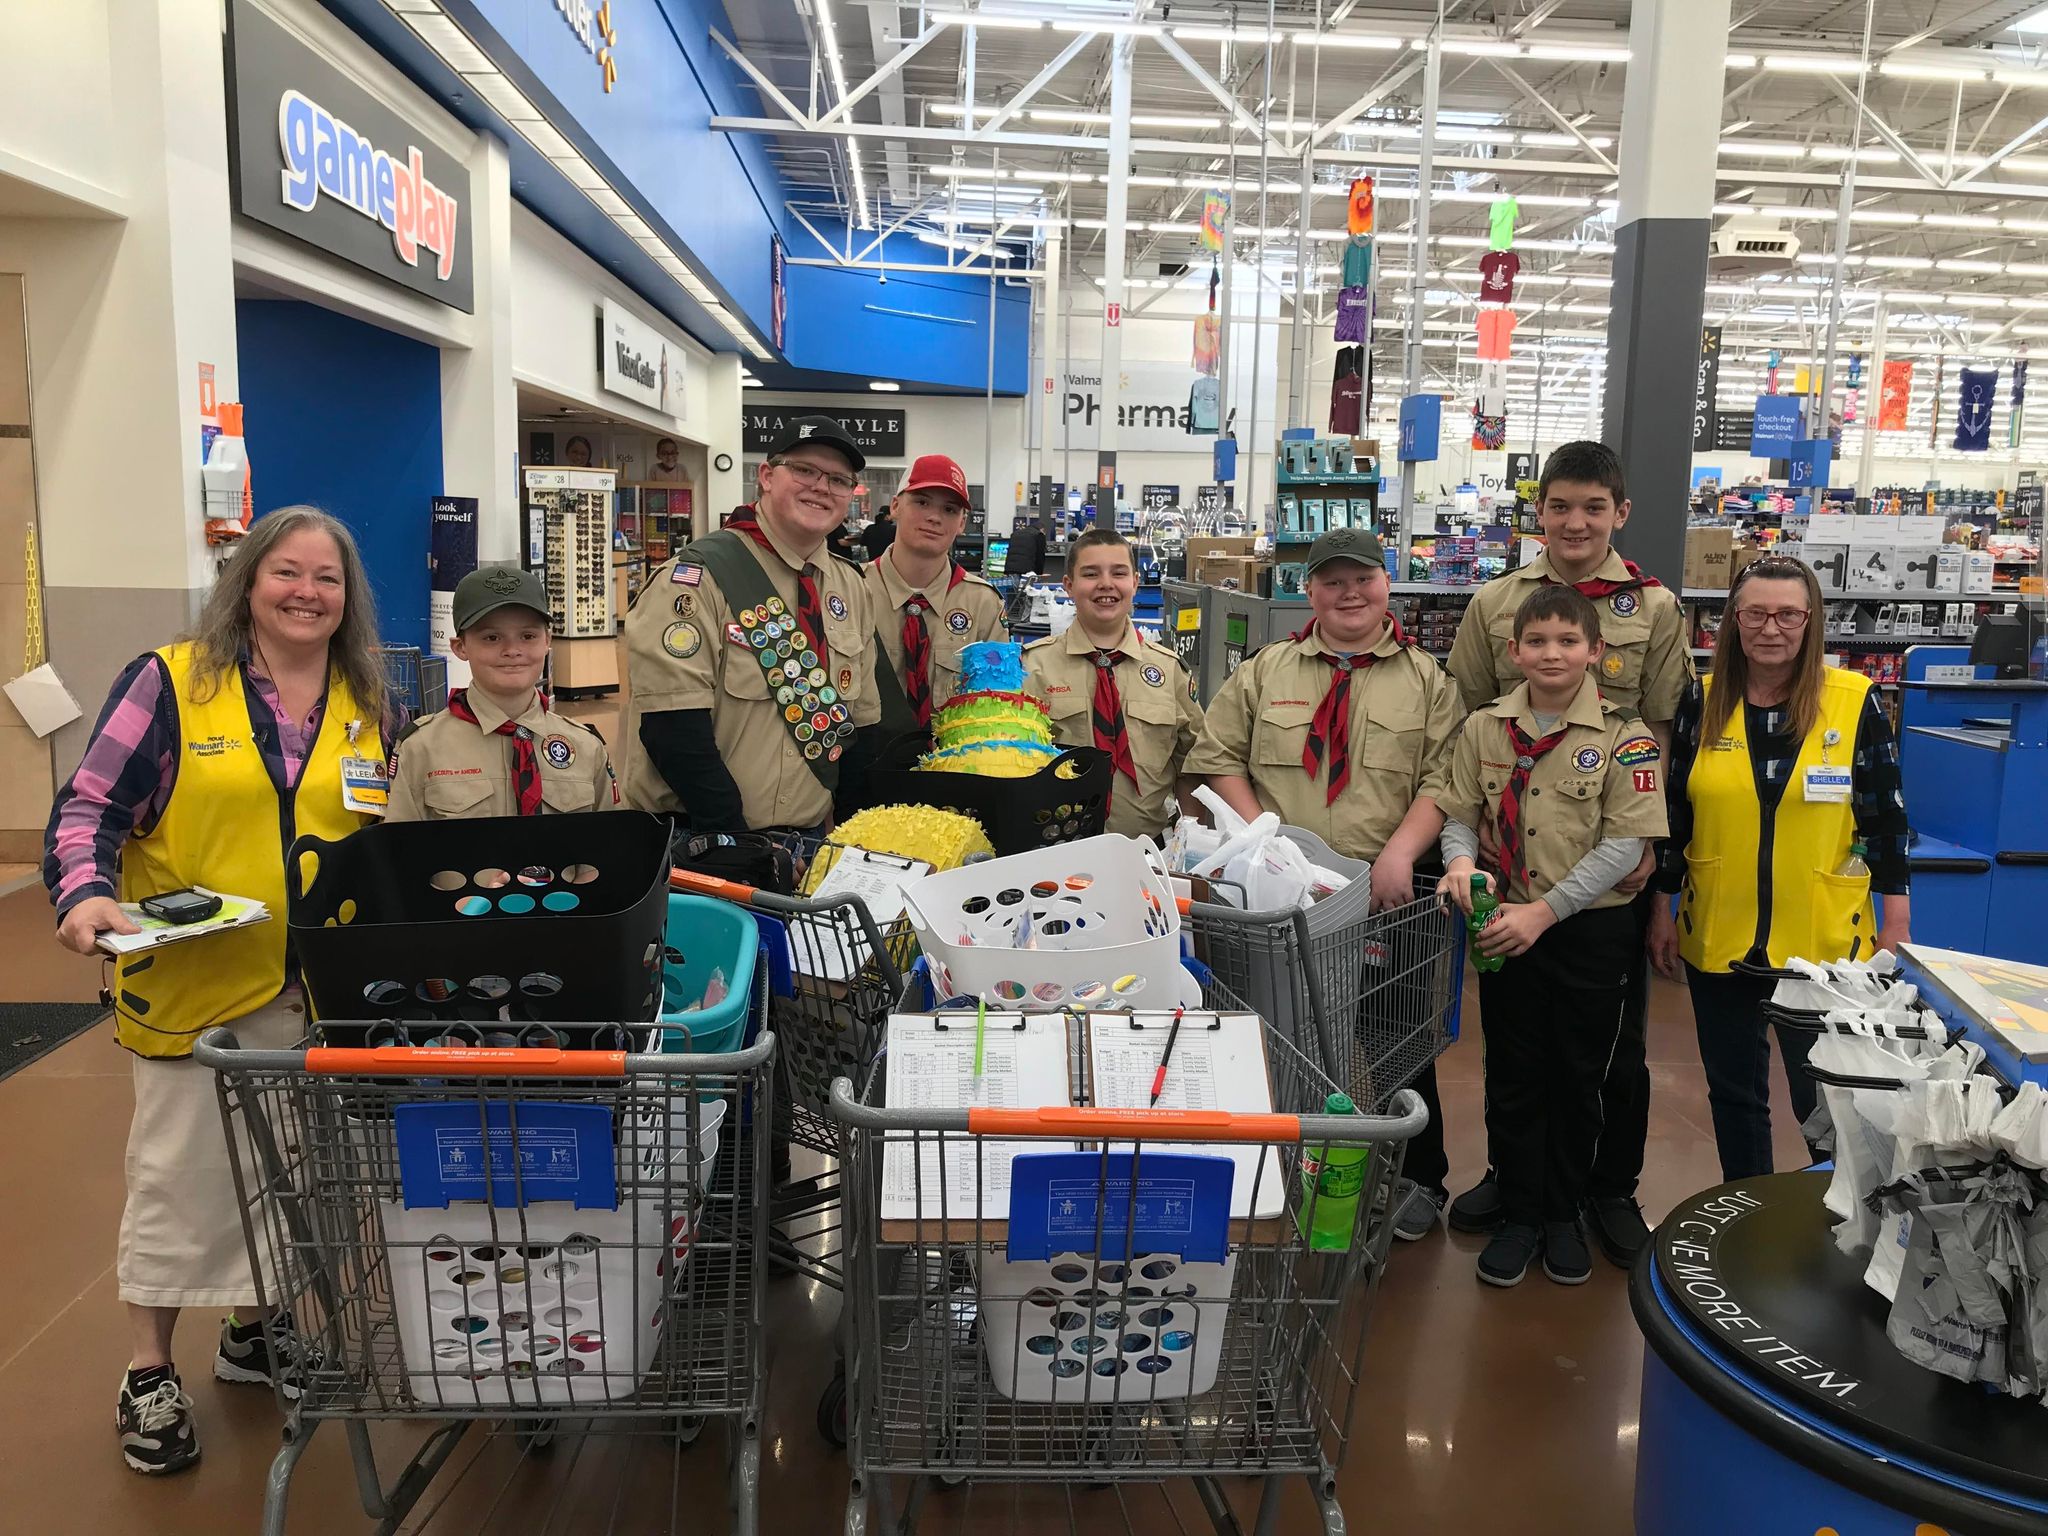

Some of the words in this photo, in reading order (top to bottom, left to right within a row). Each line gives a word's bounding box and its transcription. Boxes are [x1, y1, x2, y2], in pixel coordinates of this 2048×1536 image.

[279, 90, 457, 280] gameplay
[1064, 374, 1101, 386] Walma
[1697, 359, 1711, 395] Scan
[1062, 393, 1236, 431] Pharmay
[1757, 414, 1796, 424] Touch-free
[1693, 417, 1706, 438] Go
[1758, 423, 1792, 432] checkout
[1405, 425, 1414, 452] 14
[616, 454, 633, 464] Kids
[1792, 461, 1804, 481] 15
[1479, 474, 1506, 492] Toy
[435, 502, 457, 512] Look
[435, 512, 473, 523] yourself
[188, 742, 225, 750] Walmart
[1635, 773, 1655, 788] 73
[1812, 776, 1847, 784] SHELLEY
[1694, 1190, 1762, 1224] JUST
[1674, 1261, 1762, 1330] MORE
[1742, 1336, 1859, 1398] ITEM
